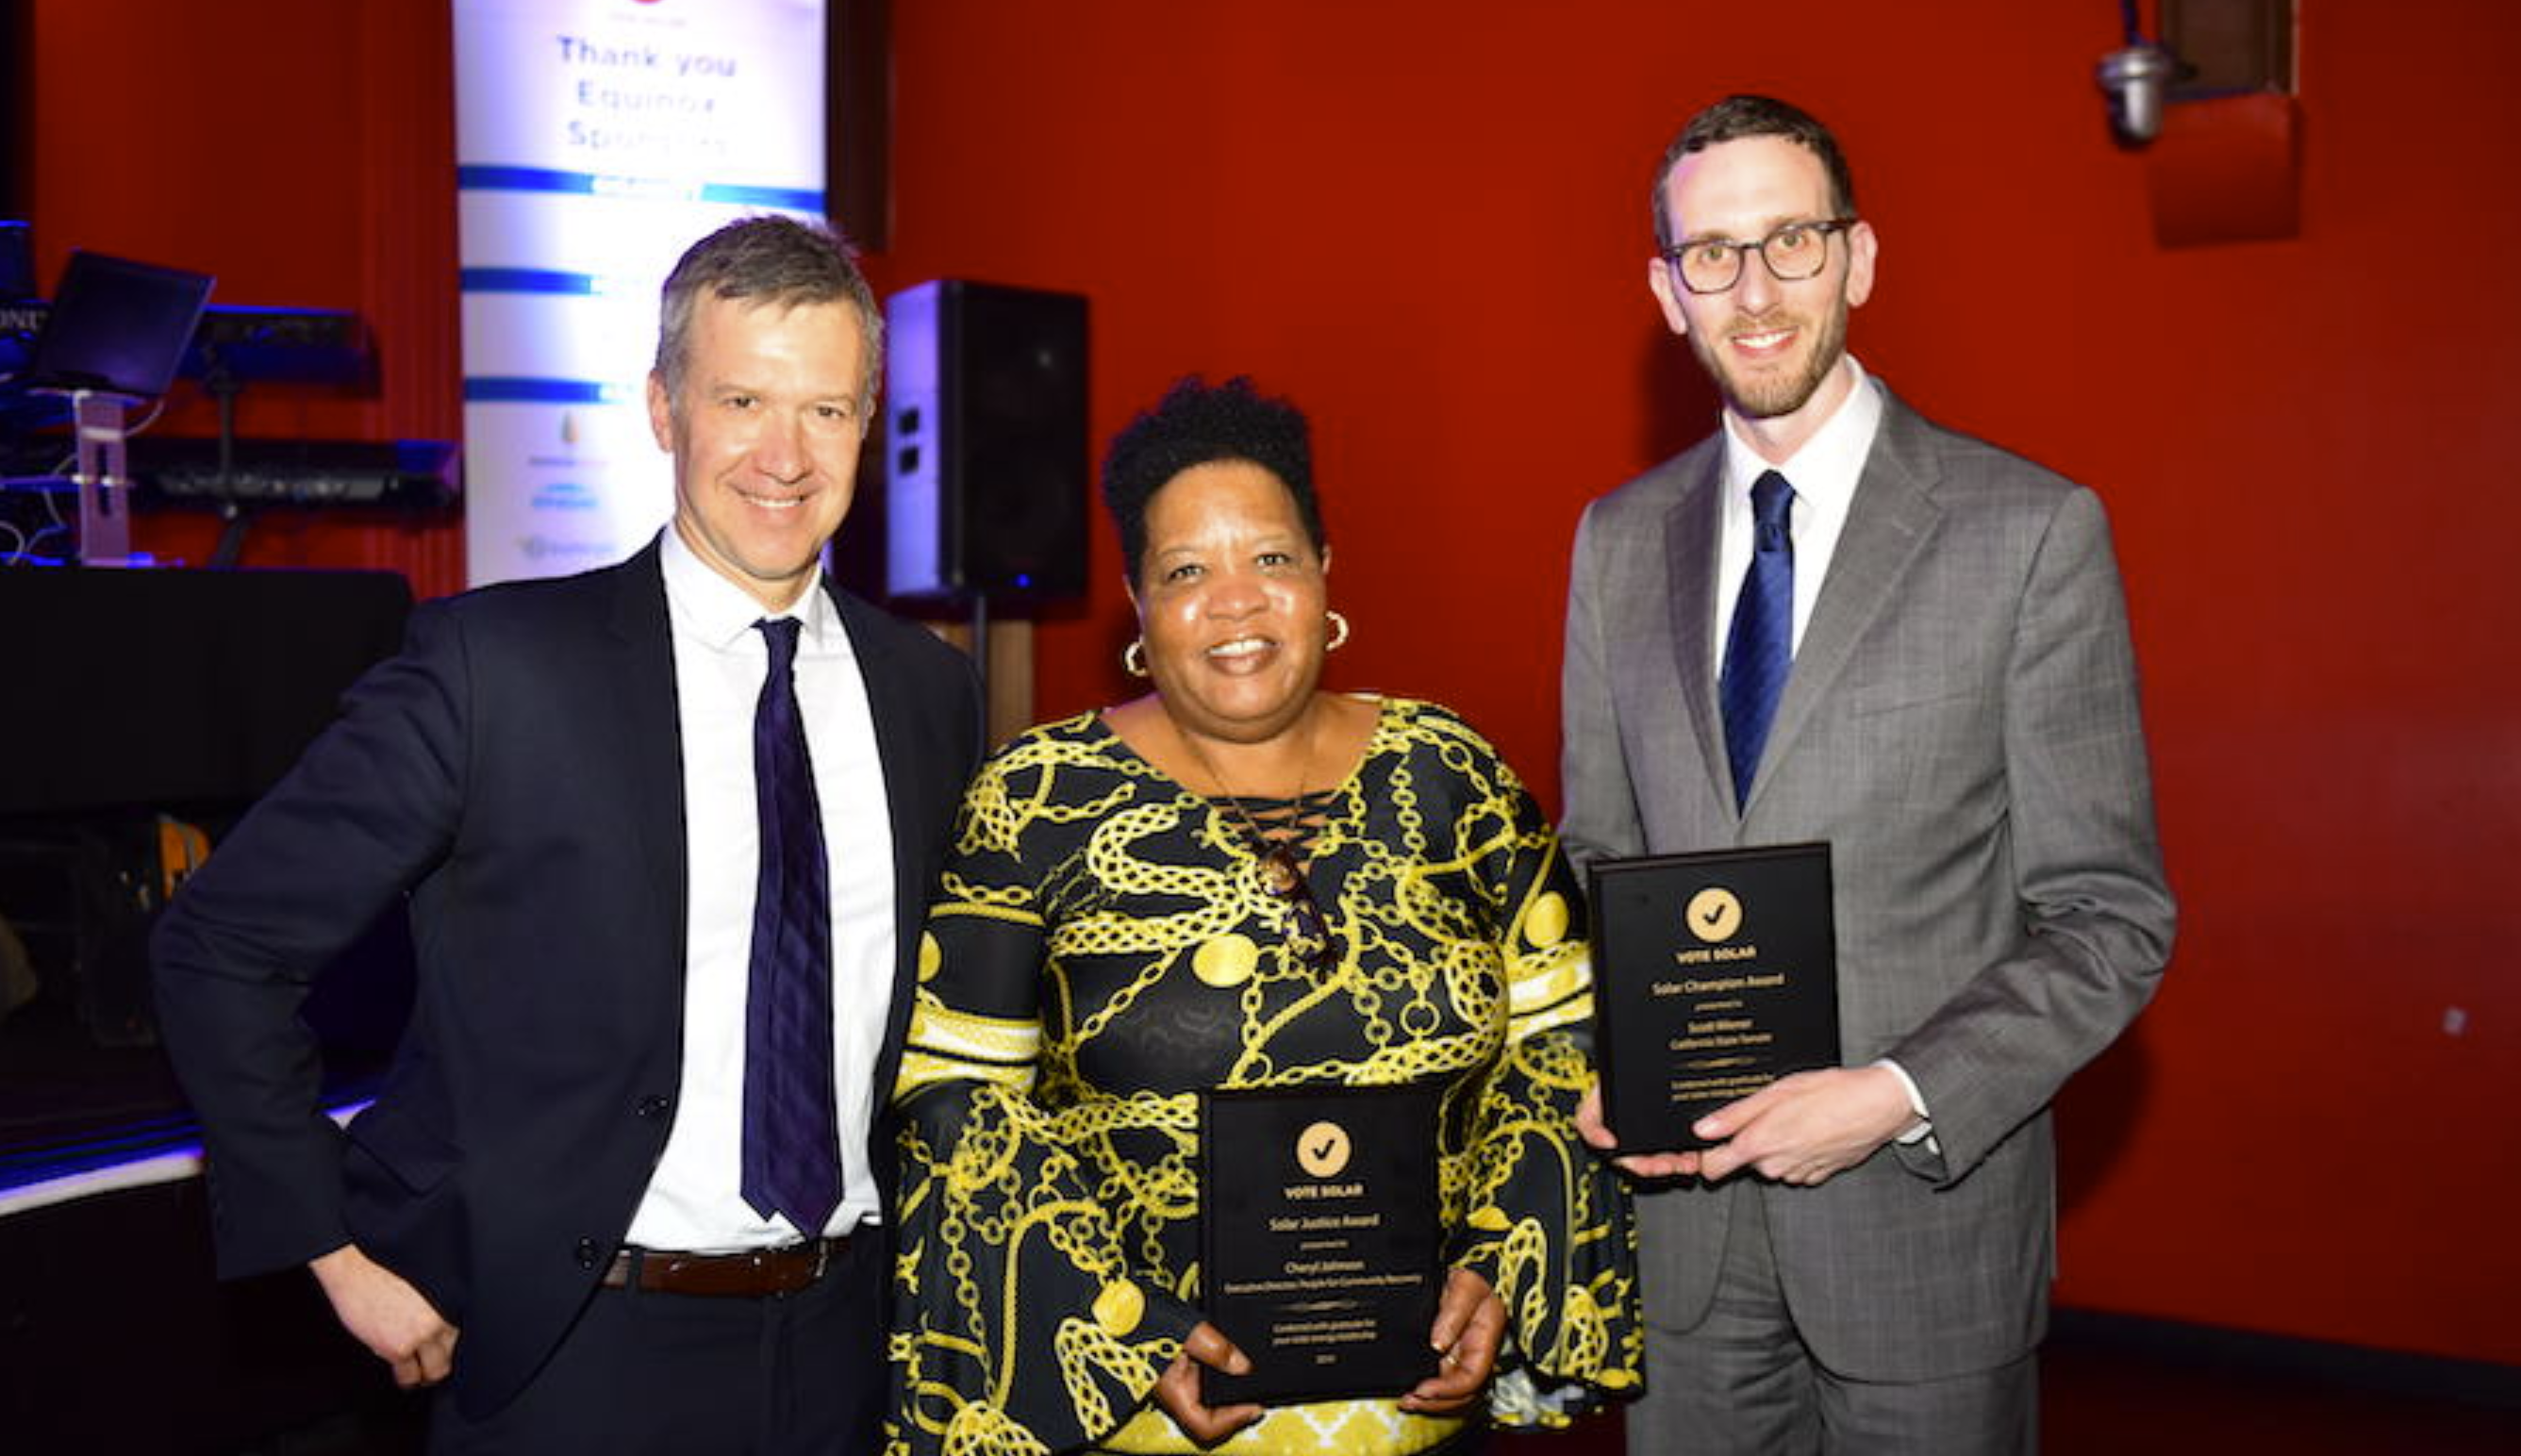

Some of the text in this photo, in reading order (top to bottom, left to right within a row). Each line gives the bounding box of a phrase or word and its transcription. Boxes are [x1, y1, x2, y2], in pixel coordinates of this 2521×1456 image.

[556, 34, 738, 76] Thank you
[1675, 945, 1757, 964] VOTE SOLAR
[1650, 973, 1785, 996] Solar Champion Award
[1284, 1183, 1364, 1200] VOTE SOLAR
[1269, 1214, 1380, 1232] Solar Justice Award
